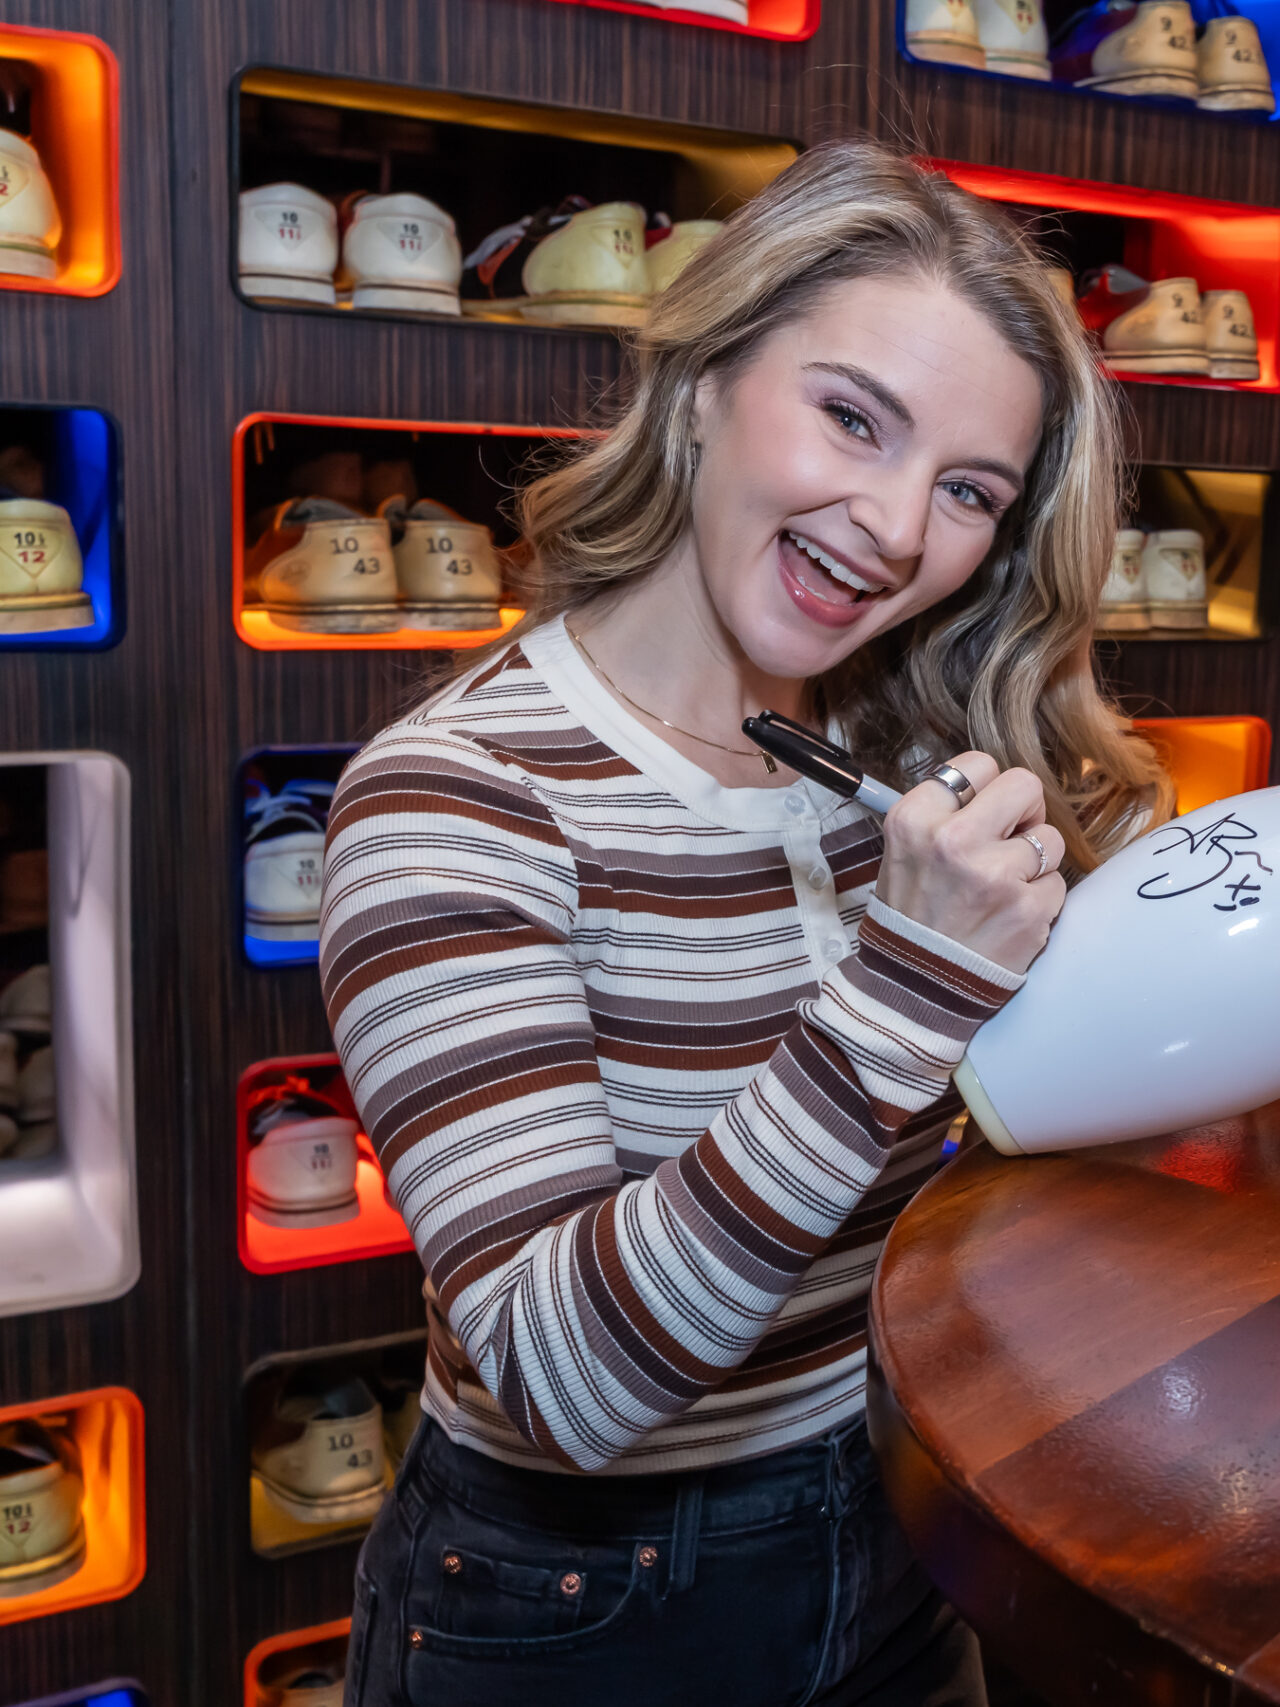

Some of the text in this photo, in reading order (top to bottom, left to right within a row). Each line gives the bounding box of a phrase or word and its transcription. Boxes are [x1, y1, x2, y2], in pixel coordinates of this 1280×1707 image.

[281, 212, 298, 224] 10
[402, 223, 419, 235] 10
[330, 537, 359, 554] 10
[427, 537, 453, 554] 10
[18, 551, 45, 563] 12
[353, 557, 380, 574] 43
[446, 559, 473, 575] 43
[328, 1434, 353, 1451] 10
[347, 1450, 373, 1468] 43
